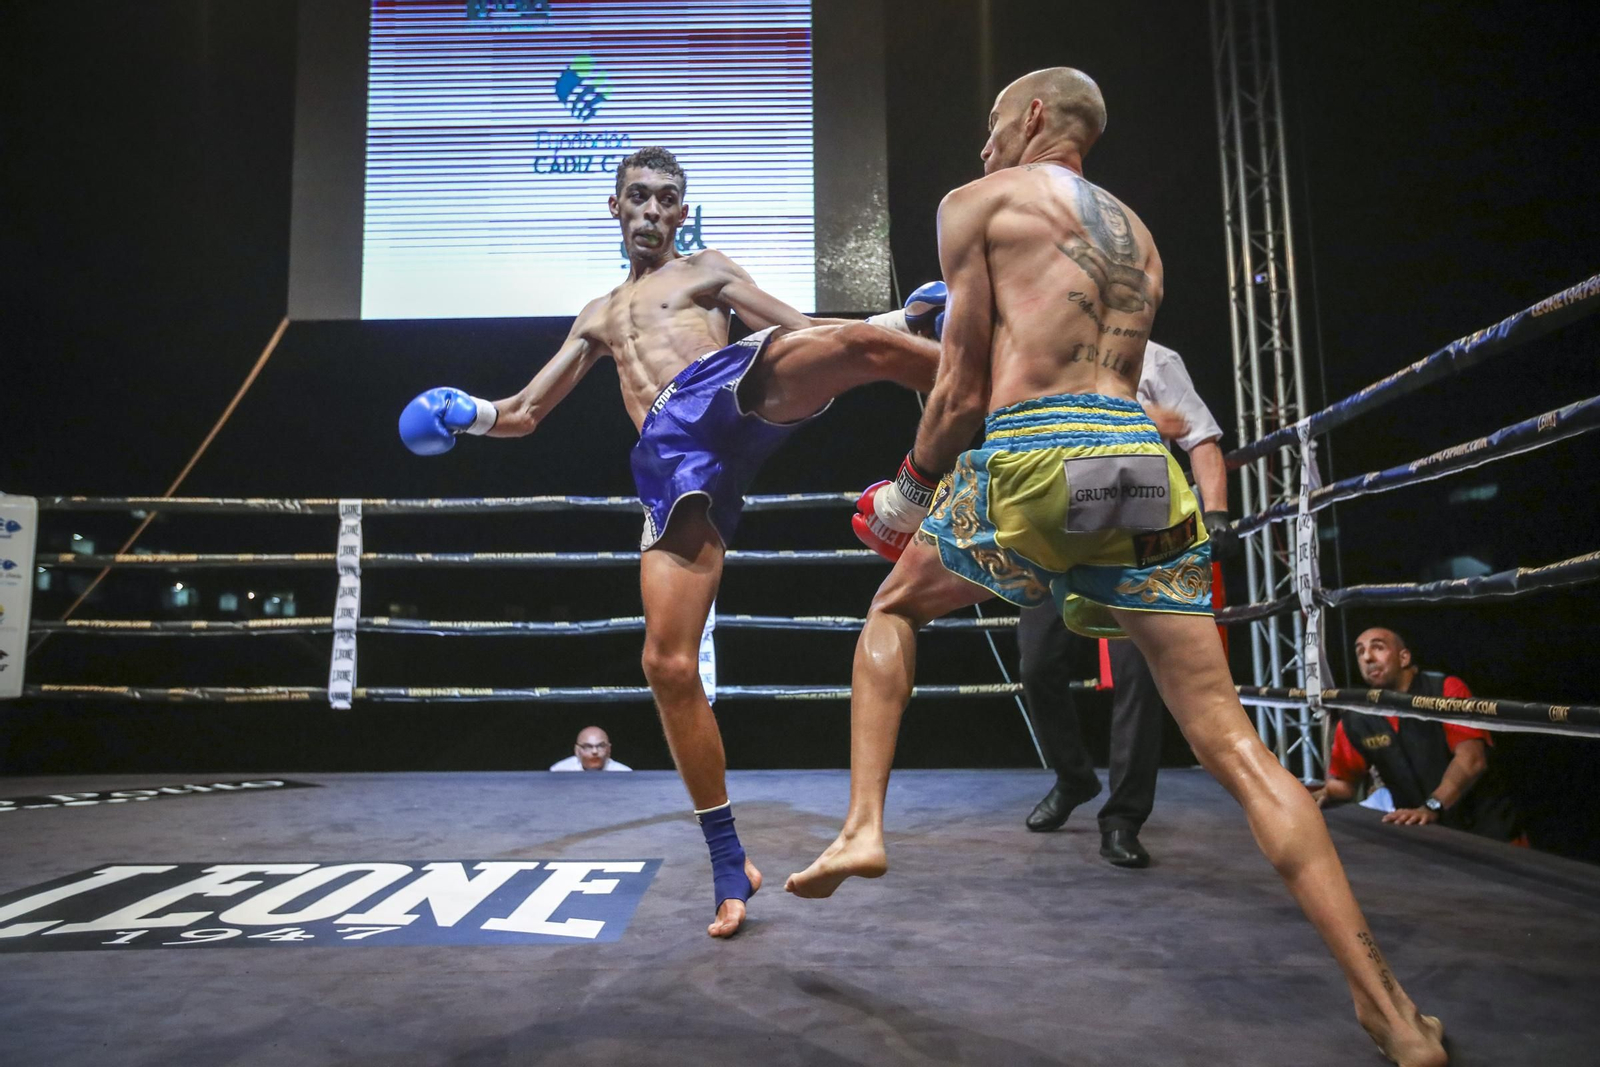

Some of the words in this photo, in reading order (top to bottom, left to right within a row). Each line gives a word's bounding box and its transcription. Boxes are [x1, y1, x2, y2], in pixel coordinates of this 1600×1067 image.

[898, 472, 932, 507] LEONE
[1075, 487, 1118, 502] GRUPO
[0, 861, 647, 939] LEONE
[101, 926, 402, 945] 1947
